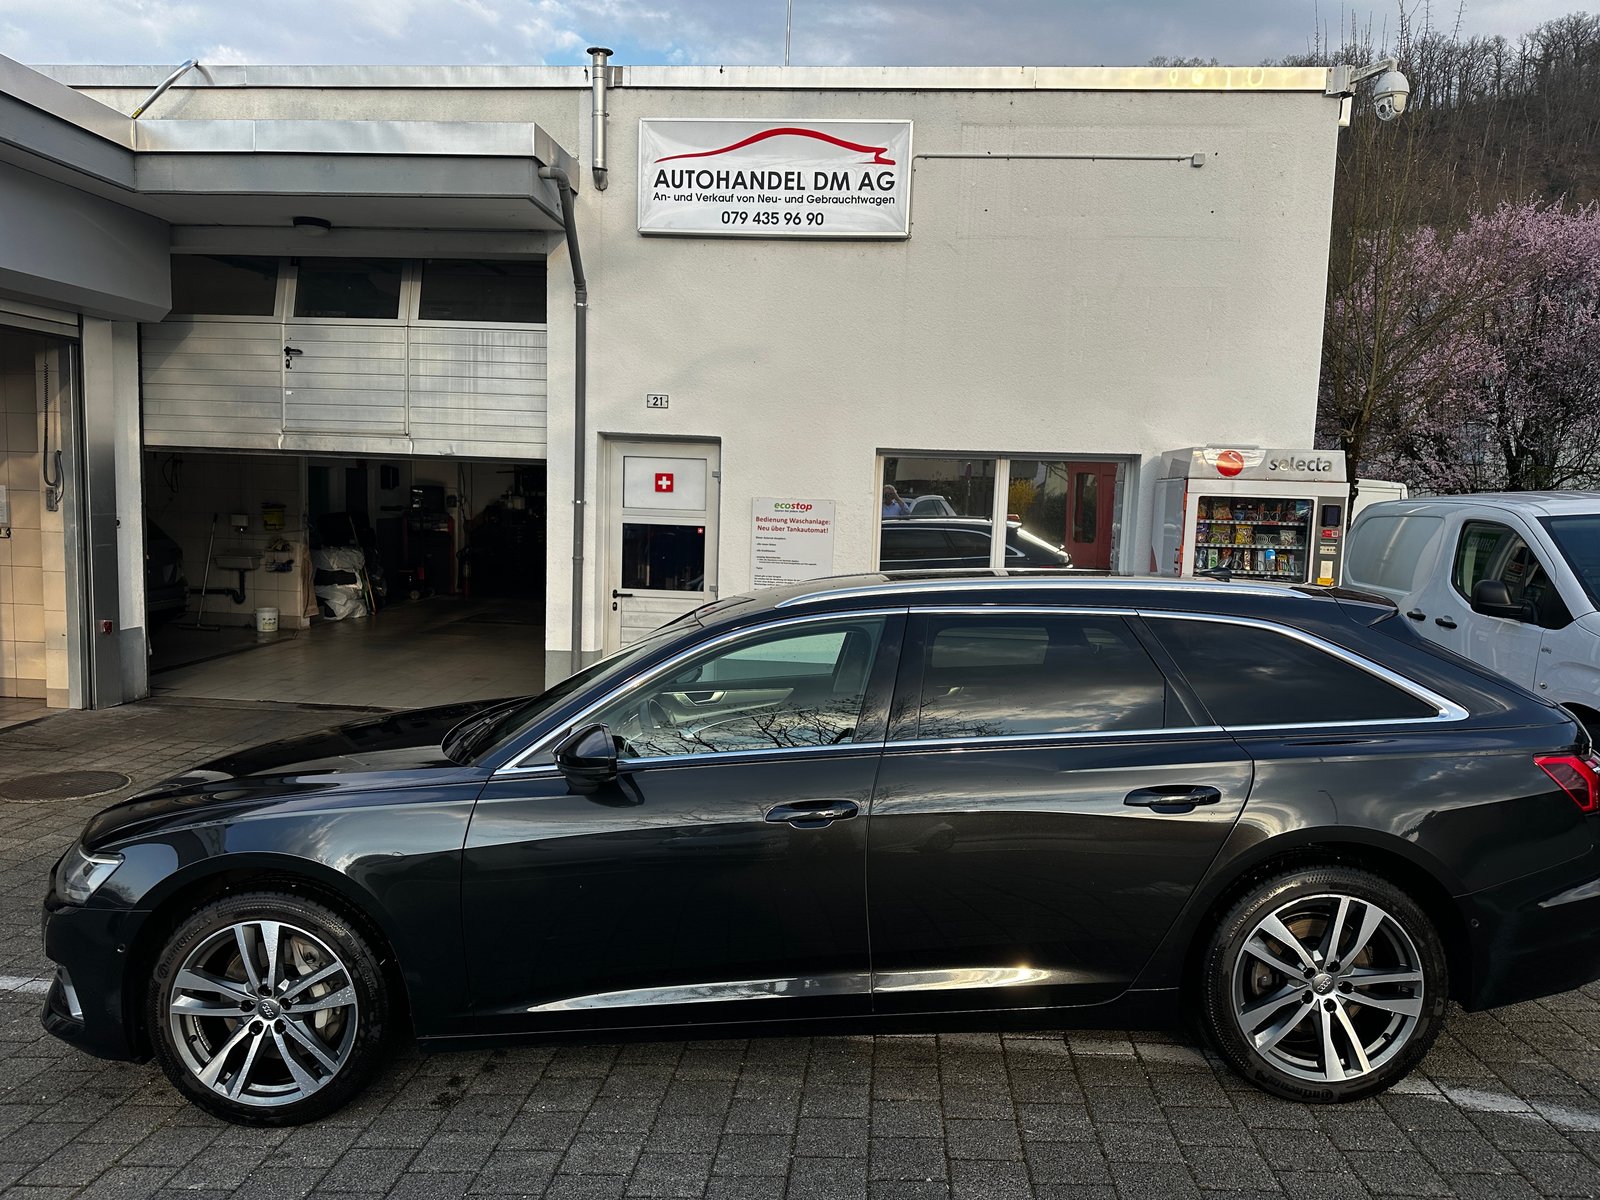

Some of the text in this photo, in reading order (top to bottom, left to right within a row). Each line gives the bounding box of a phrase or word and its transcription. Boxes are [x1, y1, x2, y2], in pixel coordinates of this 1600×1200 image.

[654, 169, 895, 191] AUTOHANDEL DM AG
[653, 192, 895, 206] An- und Verkauf von Neu- und Gebrauchtwagen
[721, 211, 824, 226] 079 435 96 90
[653, 397, 663, 406] 21
[1269, 457, 1332, 472] selecta
[774, 502, 812, 511] ecostop
[756, 516, 788, 524] Bedienung
